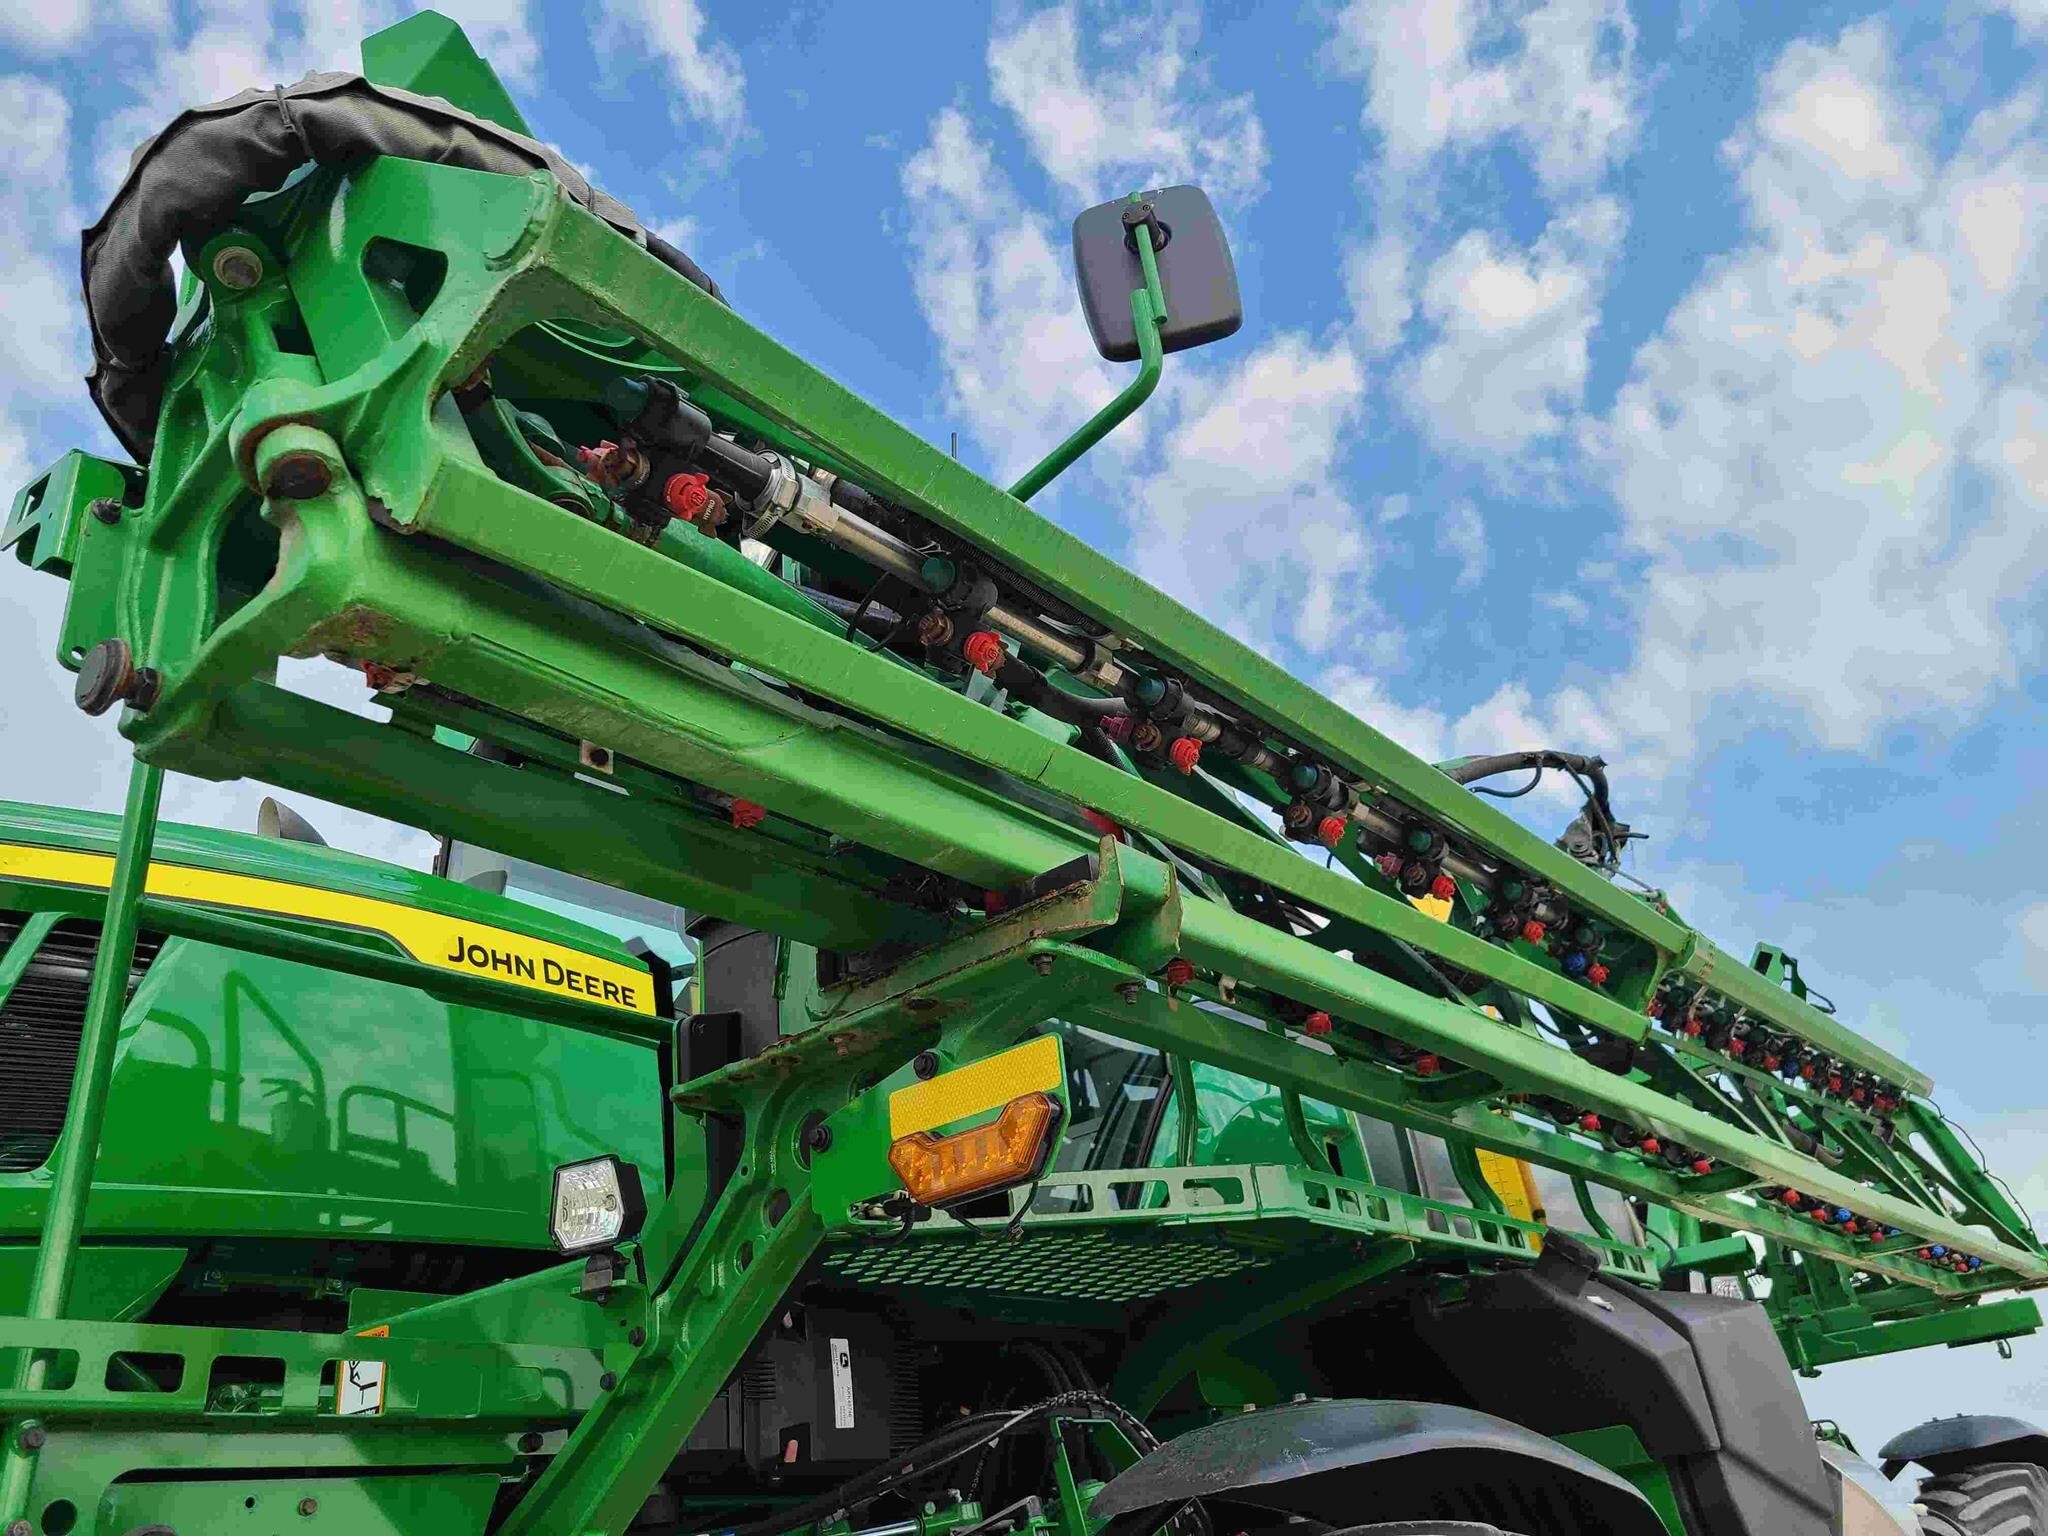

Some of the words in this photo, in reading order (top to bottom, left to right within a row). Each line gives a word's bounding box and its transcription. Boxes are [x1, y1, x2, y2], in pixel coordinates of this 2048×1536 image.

[703, 499, 716, 521] HYPRO
[448, 936, 536, 981] JOHN
[543, 958, 638, 1009] DEERE
